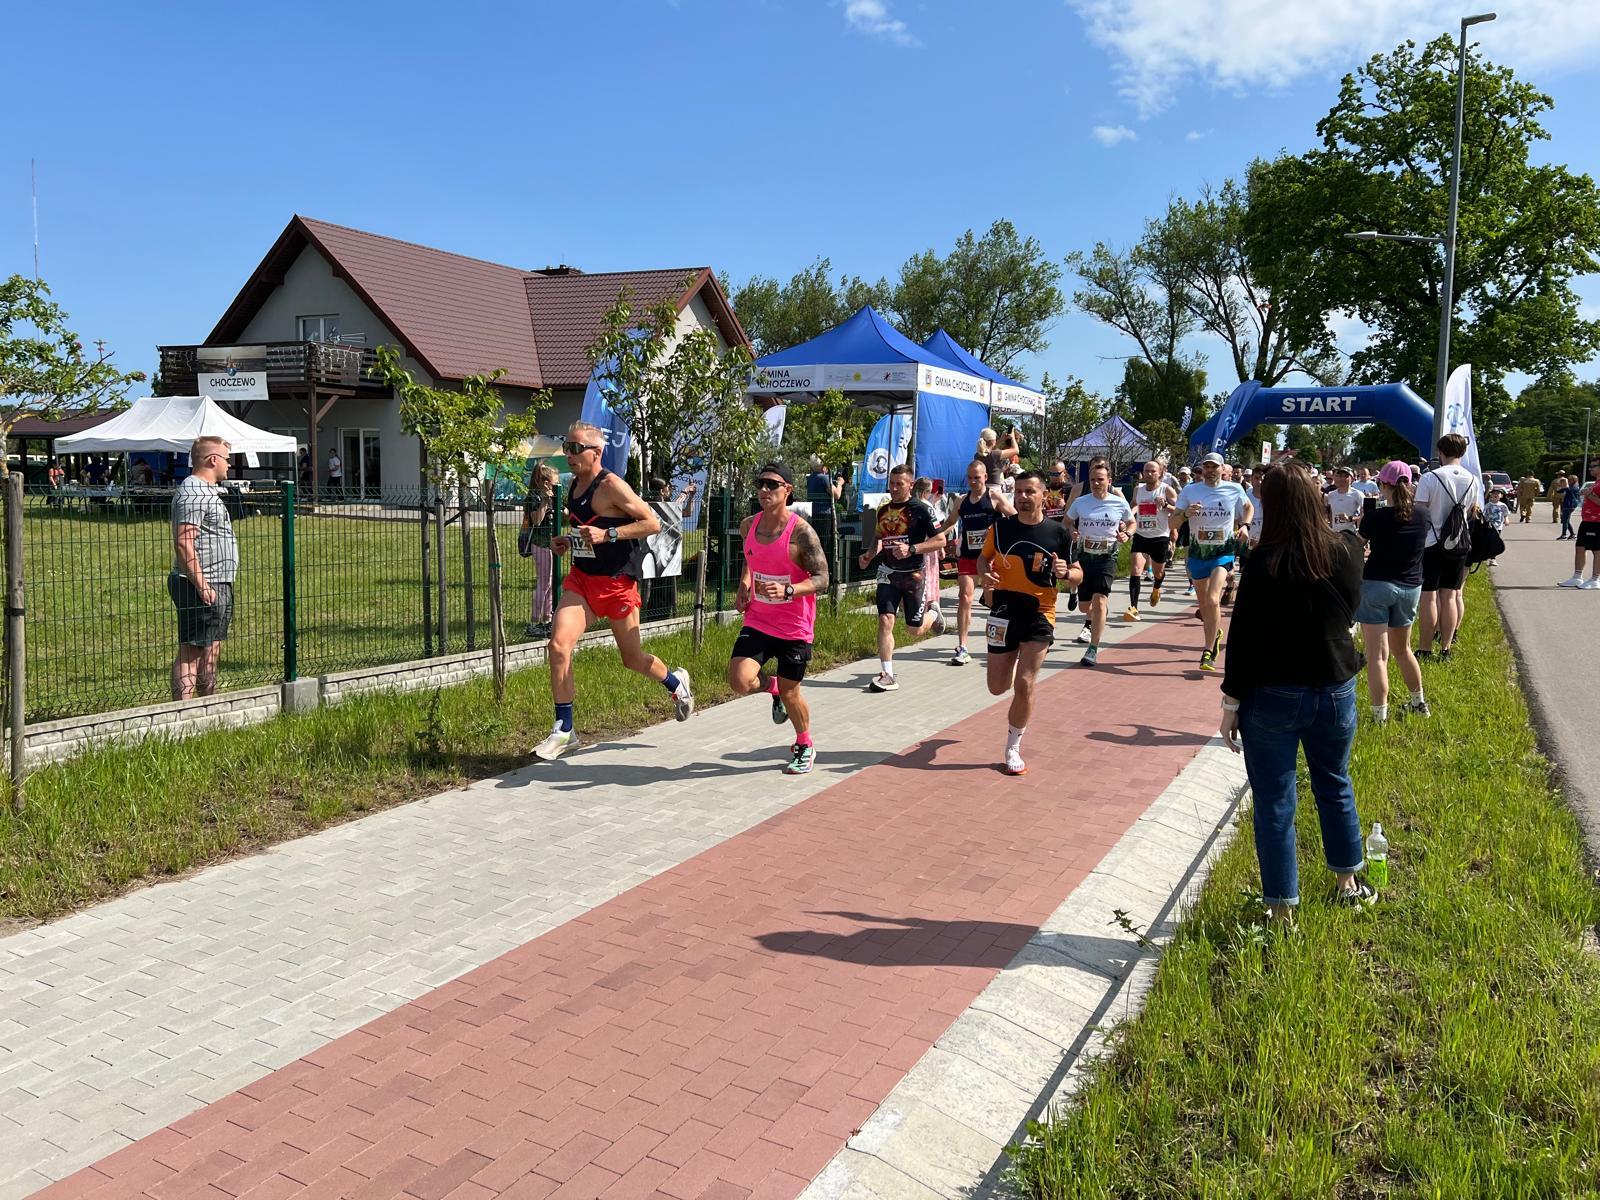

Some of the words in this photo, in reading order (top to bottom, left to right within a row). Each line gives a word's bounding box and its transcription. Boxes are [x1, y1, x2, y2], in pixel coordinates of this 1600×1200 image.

[209, 378, 256, 387] CHOCZEWO
[759, 379, 811, 389] CHOCZEWO
[935, 375, 951, 387] GMINA
[952, 379, 977, 394] CHOCZEWO
[1281, 396, 1357, 413] START
[1207, 531, 1214, 540] 9
[1090, 541, 1101, 549] 77
